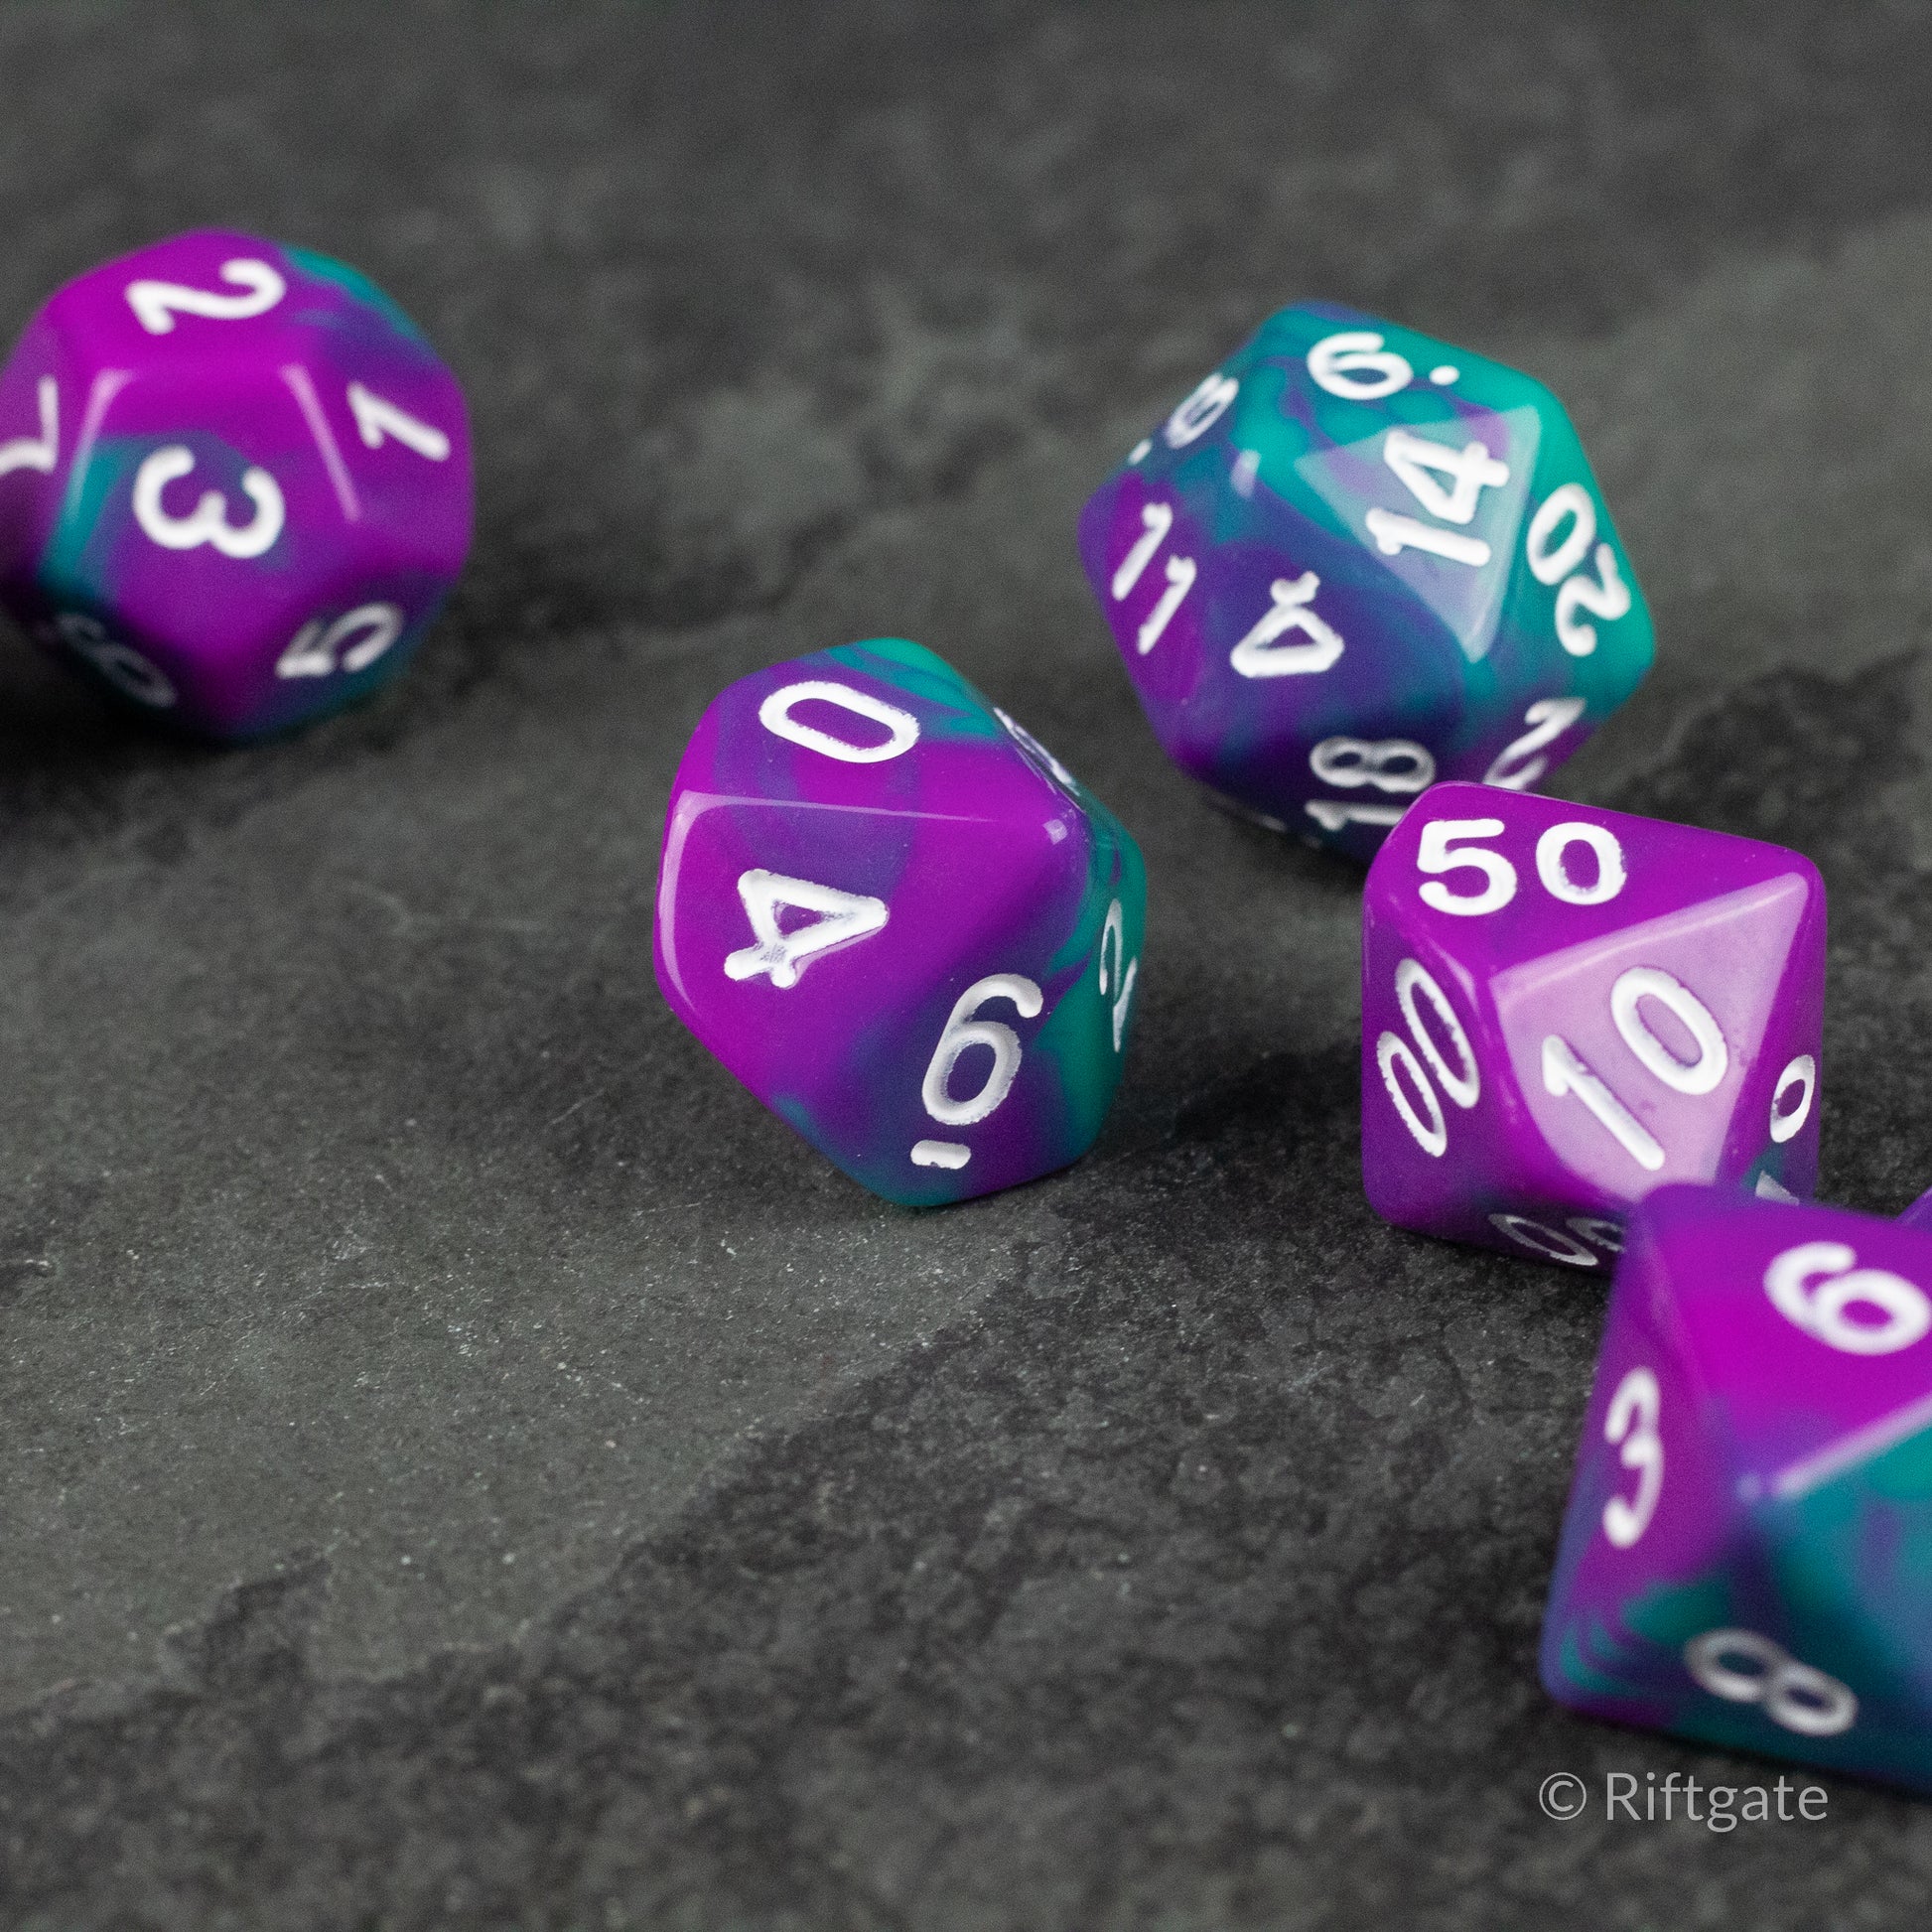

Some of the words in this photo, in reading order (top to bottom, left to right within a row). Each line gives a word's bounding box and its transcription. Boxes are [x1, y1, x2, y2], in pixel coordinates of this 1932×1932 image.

[126, 259, 286, 334] 2
[347, 382, 451, 461] 1
[133, 446, 285, 558] 3
[1368, 429, 1509, 567] 14
[1527, 483, 1631, 656] 20
[275, 602, 401, 679] 5
[1230, 571, 1345, 678] 4
[759, 680, 920, 763] 0
[1307, 737, 1437, 831] 18
[1417, 818, 1627, 915] 50
[724, 868, 889, 989] 4
[1376, 957, 1481, 1158] 00
[1541, 966, 1728, 1172] 10
[1763, 1241, 1932, 1355] 6
[1603, 1366, 1664, 1548] 3
[1688, 1629, 1858, 1736] 8
